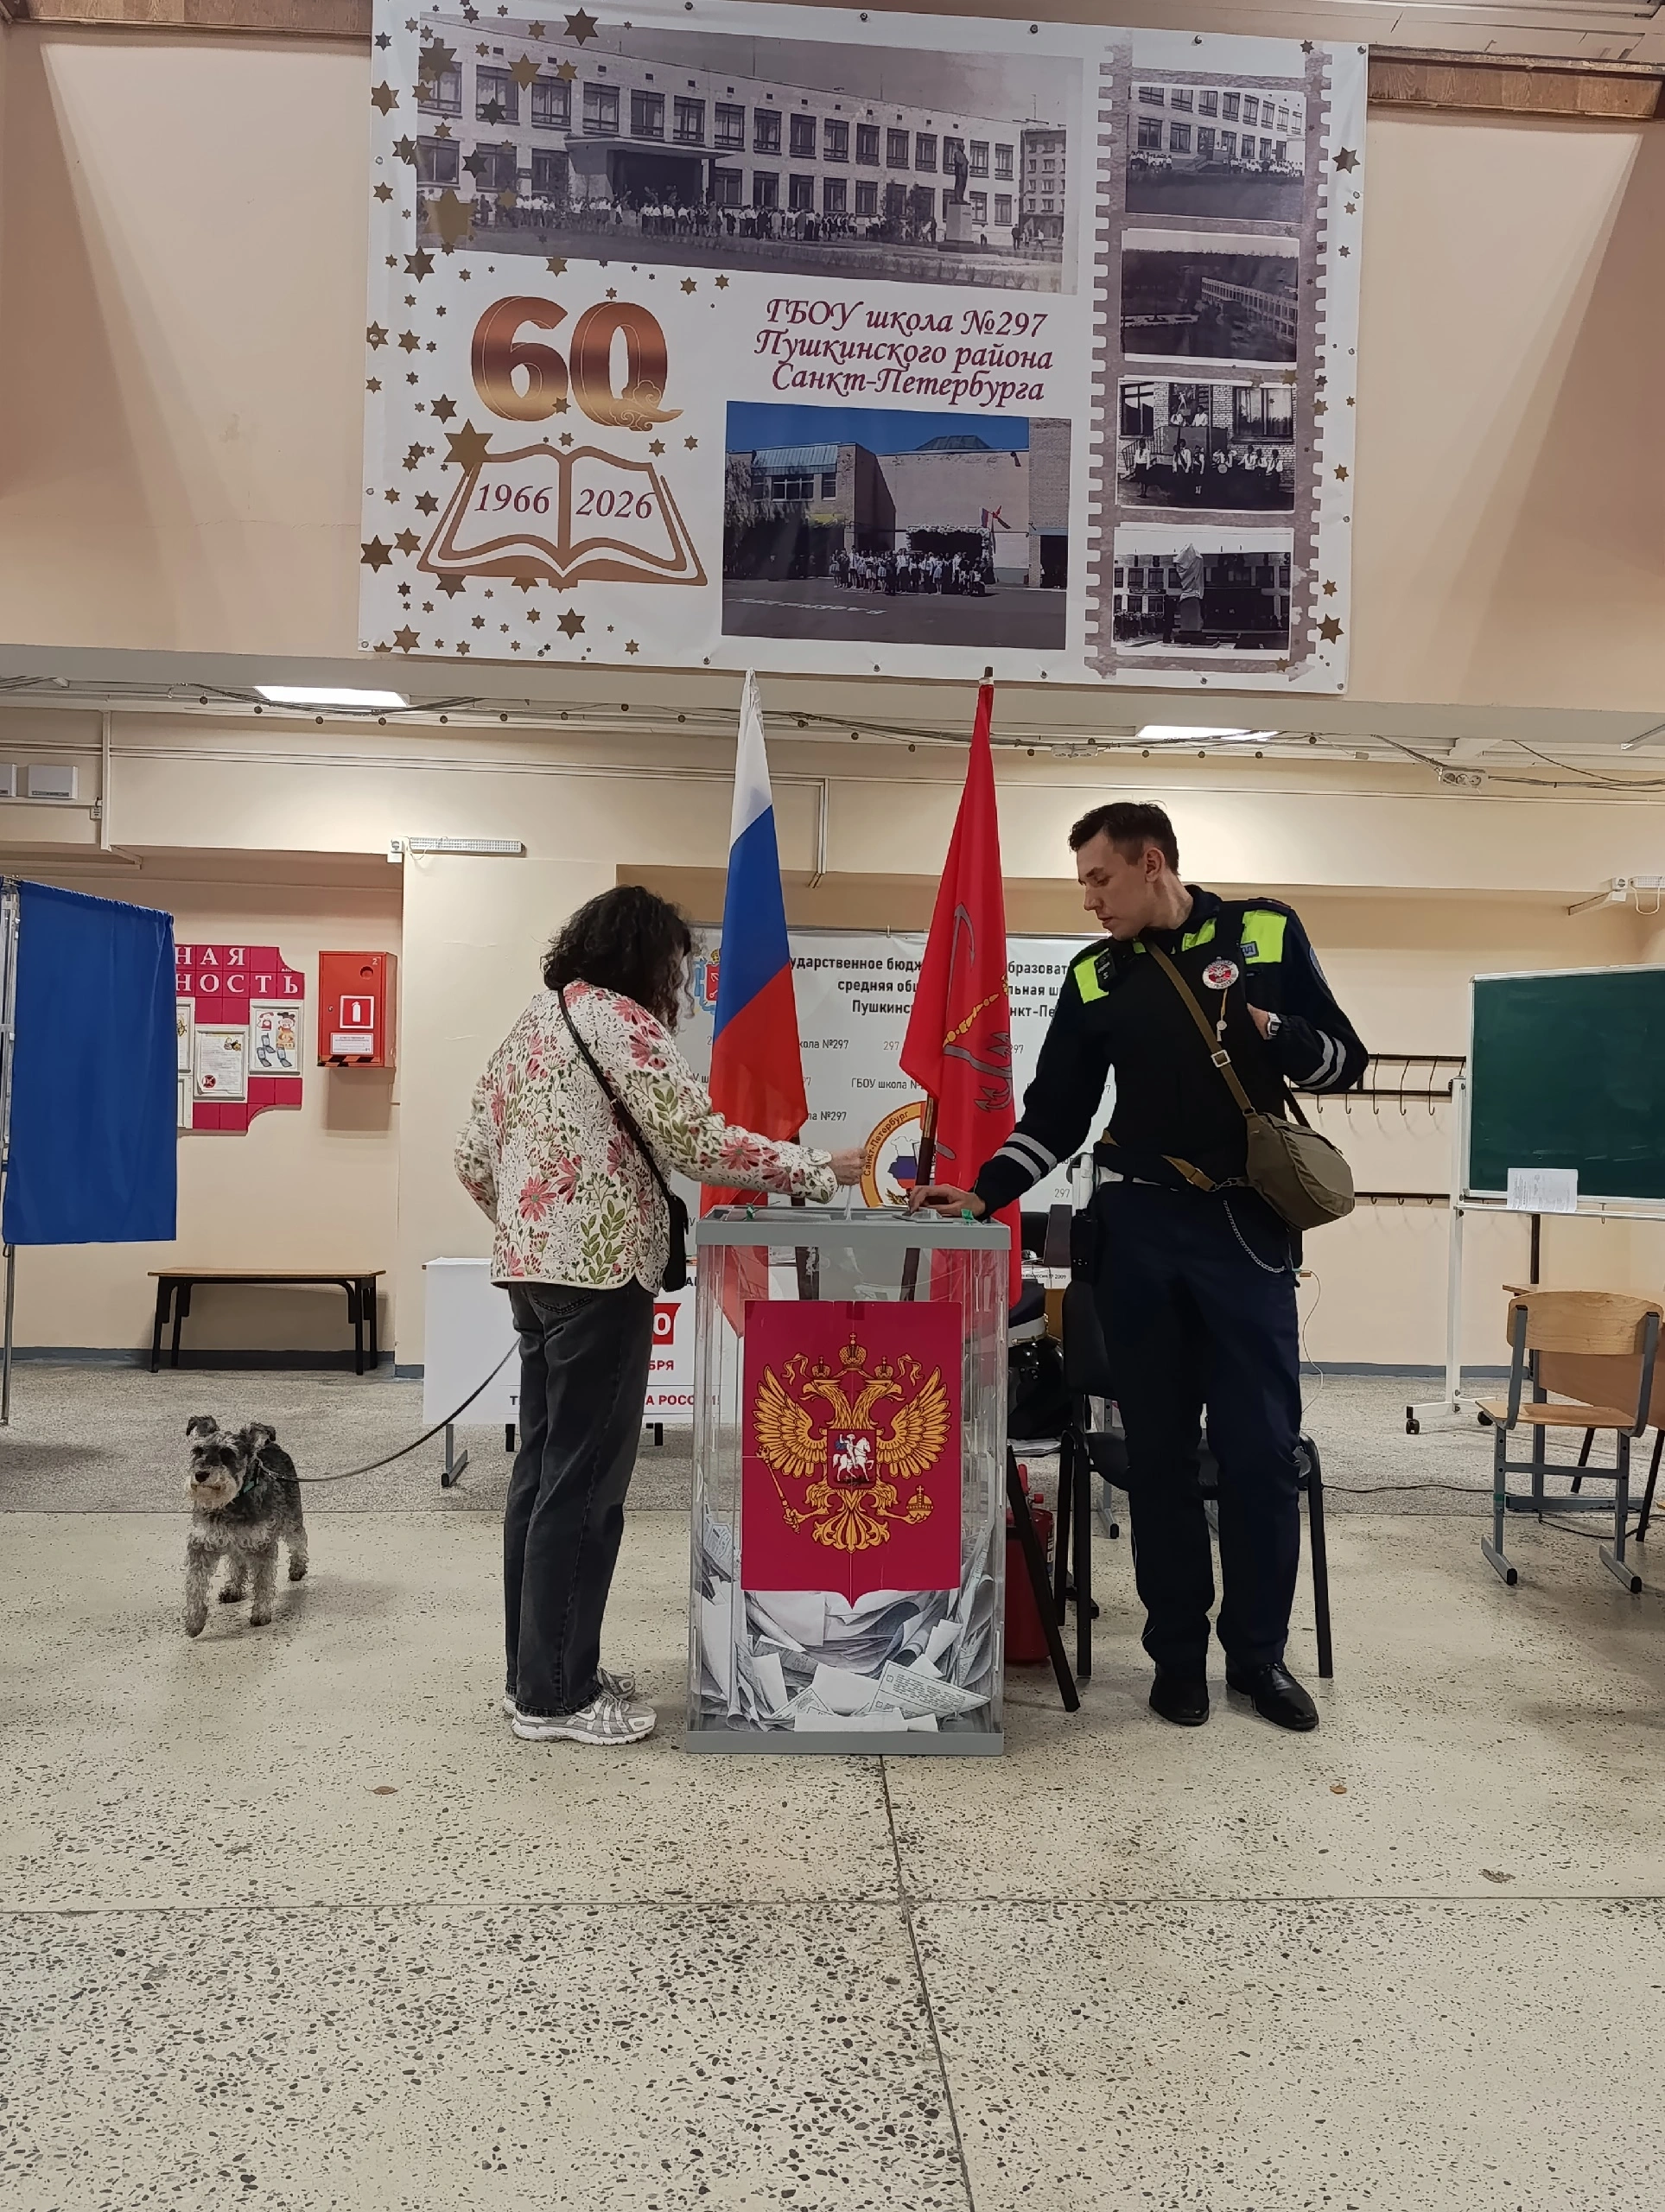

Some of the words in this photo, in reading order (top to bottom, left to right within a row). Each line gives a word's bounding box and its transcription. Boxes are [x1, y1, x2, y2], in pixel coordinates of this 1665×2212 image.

[766, 298, 864, 331] ГБОУ
[866, 309, 954, 337] школа
[960, 309, 1048, 338] №297
[753, 328, 948, 371] Пушкинского
[951, 344, 1054, 373] района
[471, 296, 683, 431] 60
[772, 363, 1045, 408] Санкт-Петербурга
[473, 483, 553, 514] 1966
[575, 488, 656, 519] 2026
[175, 947, 245, 966] НАЯ
[791, 957, 883, 971] ударственное
[887, 957, 922, 972] бюдж
[1007, 961, 1069, 976] бразоват
[175, 974, 299, 995] НОСТЬ
[837, 980, 893, 994] средняя
[1007, 986, 1045, 996] льная
[852, 1000, 914, 1016] Пушкинс
[1009, 1005, 1056, 1018] нкт-Пе
[822, 1039, 849, 1050] №297
[883, 1040, 899, 1051] 297
[851, 1077, 876, 1089] ГБОУ
[878, 1080, 907, 1090] школа
[820, 1110, 847, 1122] №297
[864, 1111, 909, 1176] Санкт-Петербург
[1054, 1188, 1071, 1198] 297
[649, 1359, 674, 1371] БРЯ
